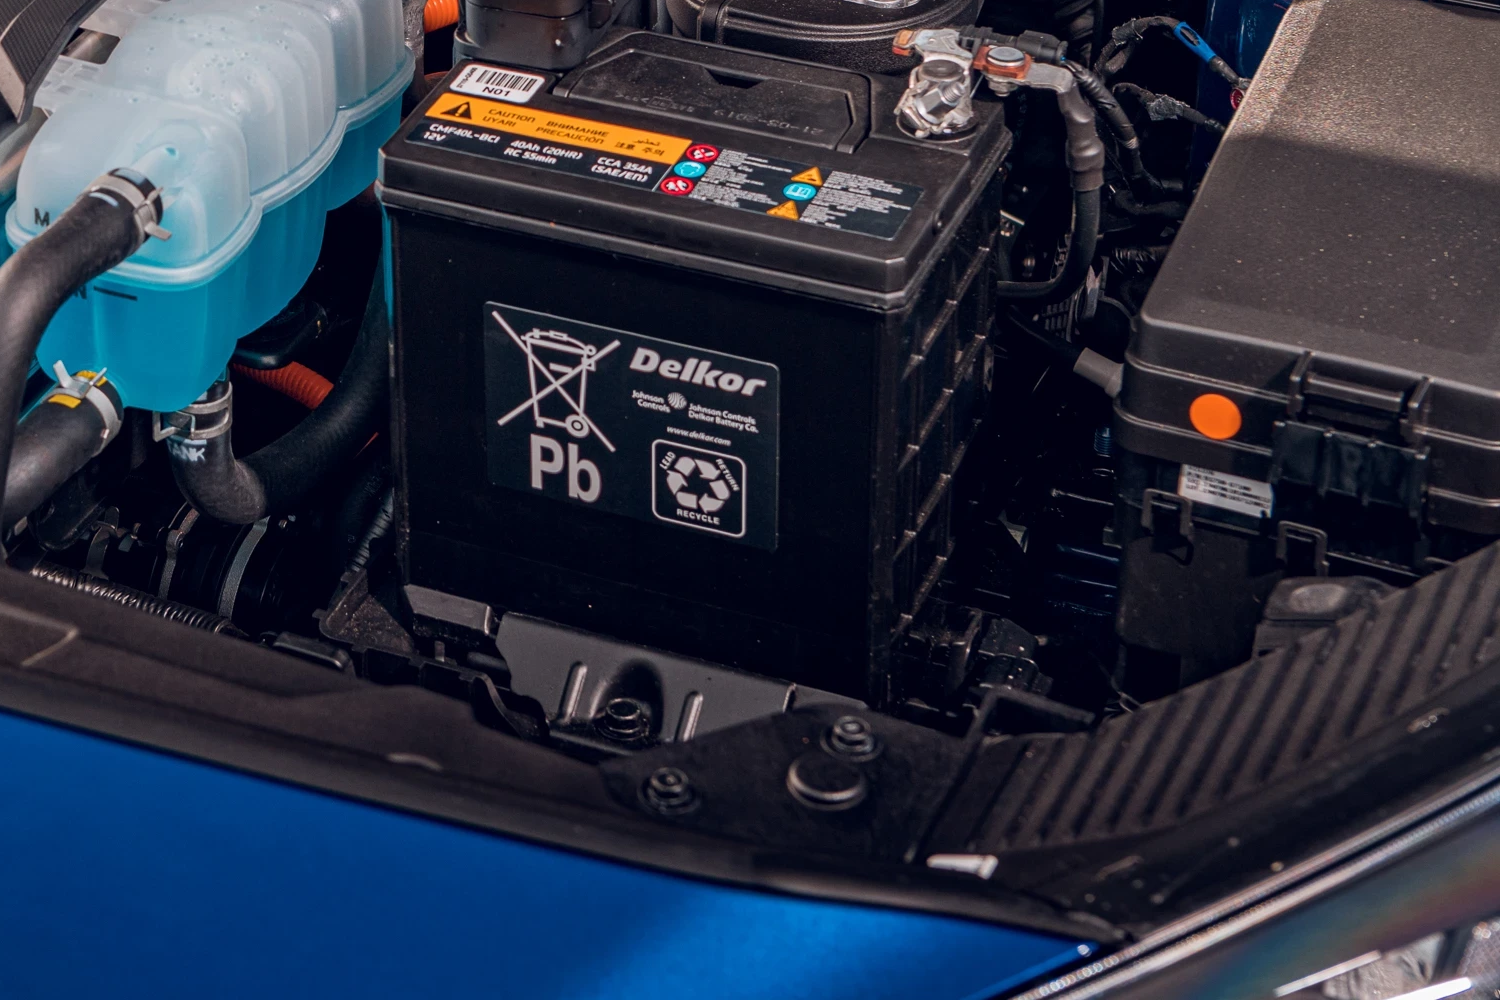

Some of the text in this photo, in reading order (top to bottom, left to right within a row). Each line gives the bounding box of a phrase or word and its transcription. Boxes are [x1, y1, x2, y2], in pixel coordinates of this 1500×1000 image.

[482, 116, 517, 128] UYARI
[488, 108, 536, 123] CAUTION
[423, 131, 447, 142] 12V
[429, 123, 501, 144] CMF40L-BCI
[503, 147, 558, 165] RC 55min
[510, 139, 584, 160] 40Ah (20HR)
[597, 156, 653, 175] CCA 354A
[629, 346, 768, 397] Delkor
[632, 389, 665, 404] Johnson
[637, 398, 671, 413] Controls
[687, 410, 759, 433] Delkor Battery Co.
[689, 403, 756, 424] Johnson Controls
[666, 425, 732, 446] www.delkor.com
[530, 433, 603, 503] Pb
[659, 450, 677, 470] LEAD
[715, 457, 740, 492] RETURN
[676, 507, 721, 525] RECYCLE
